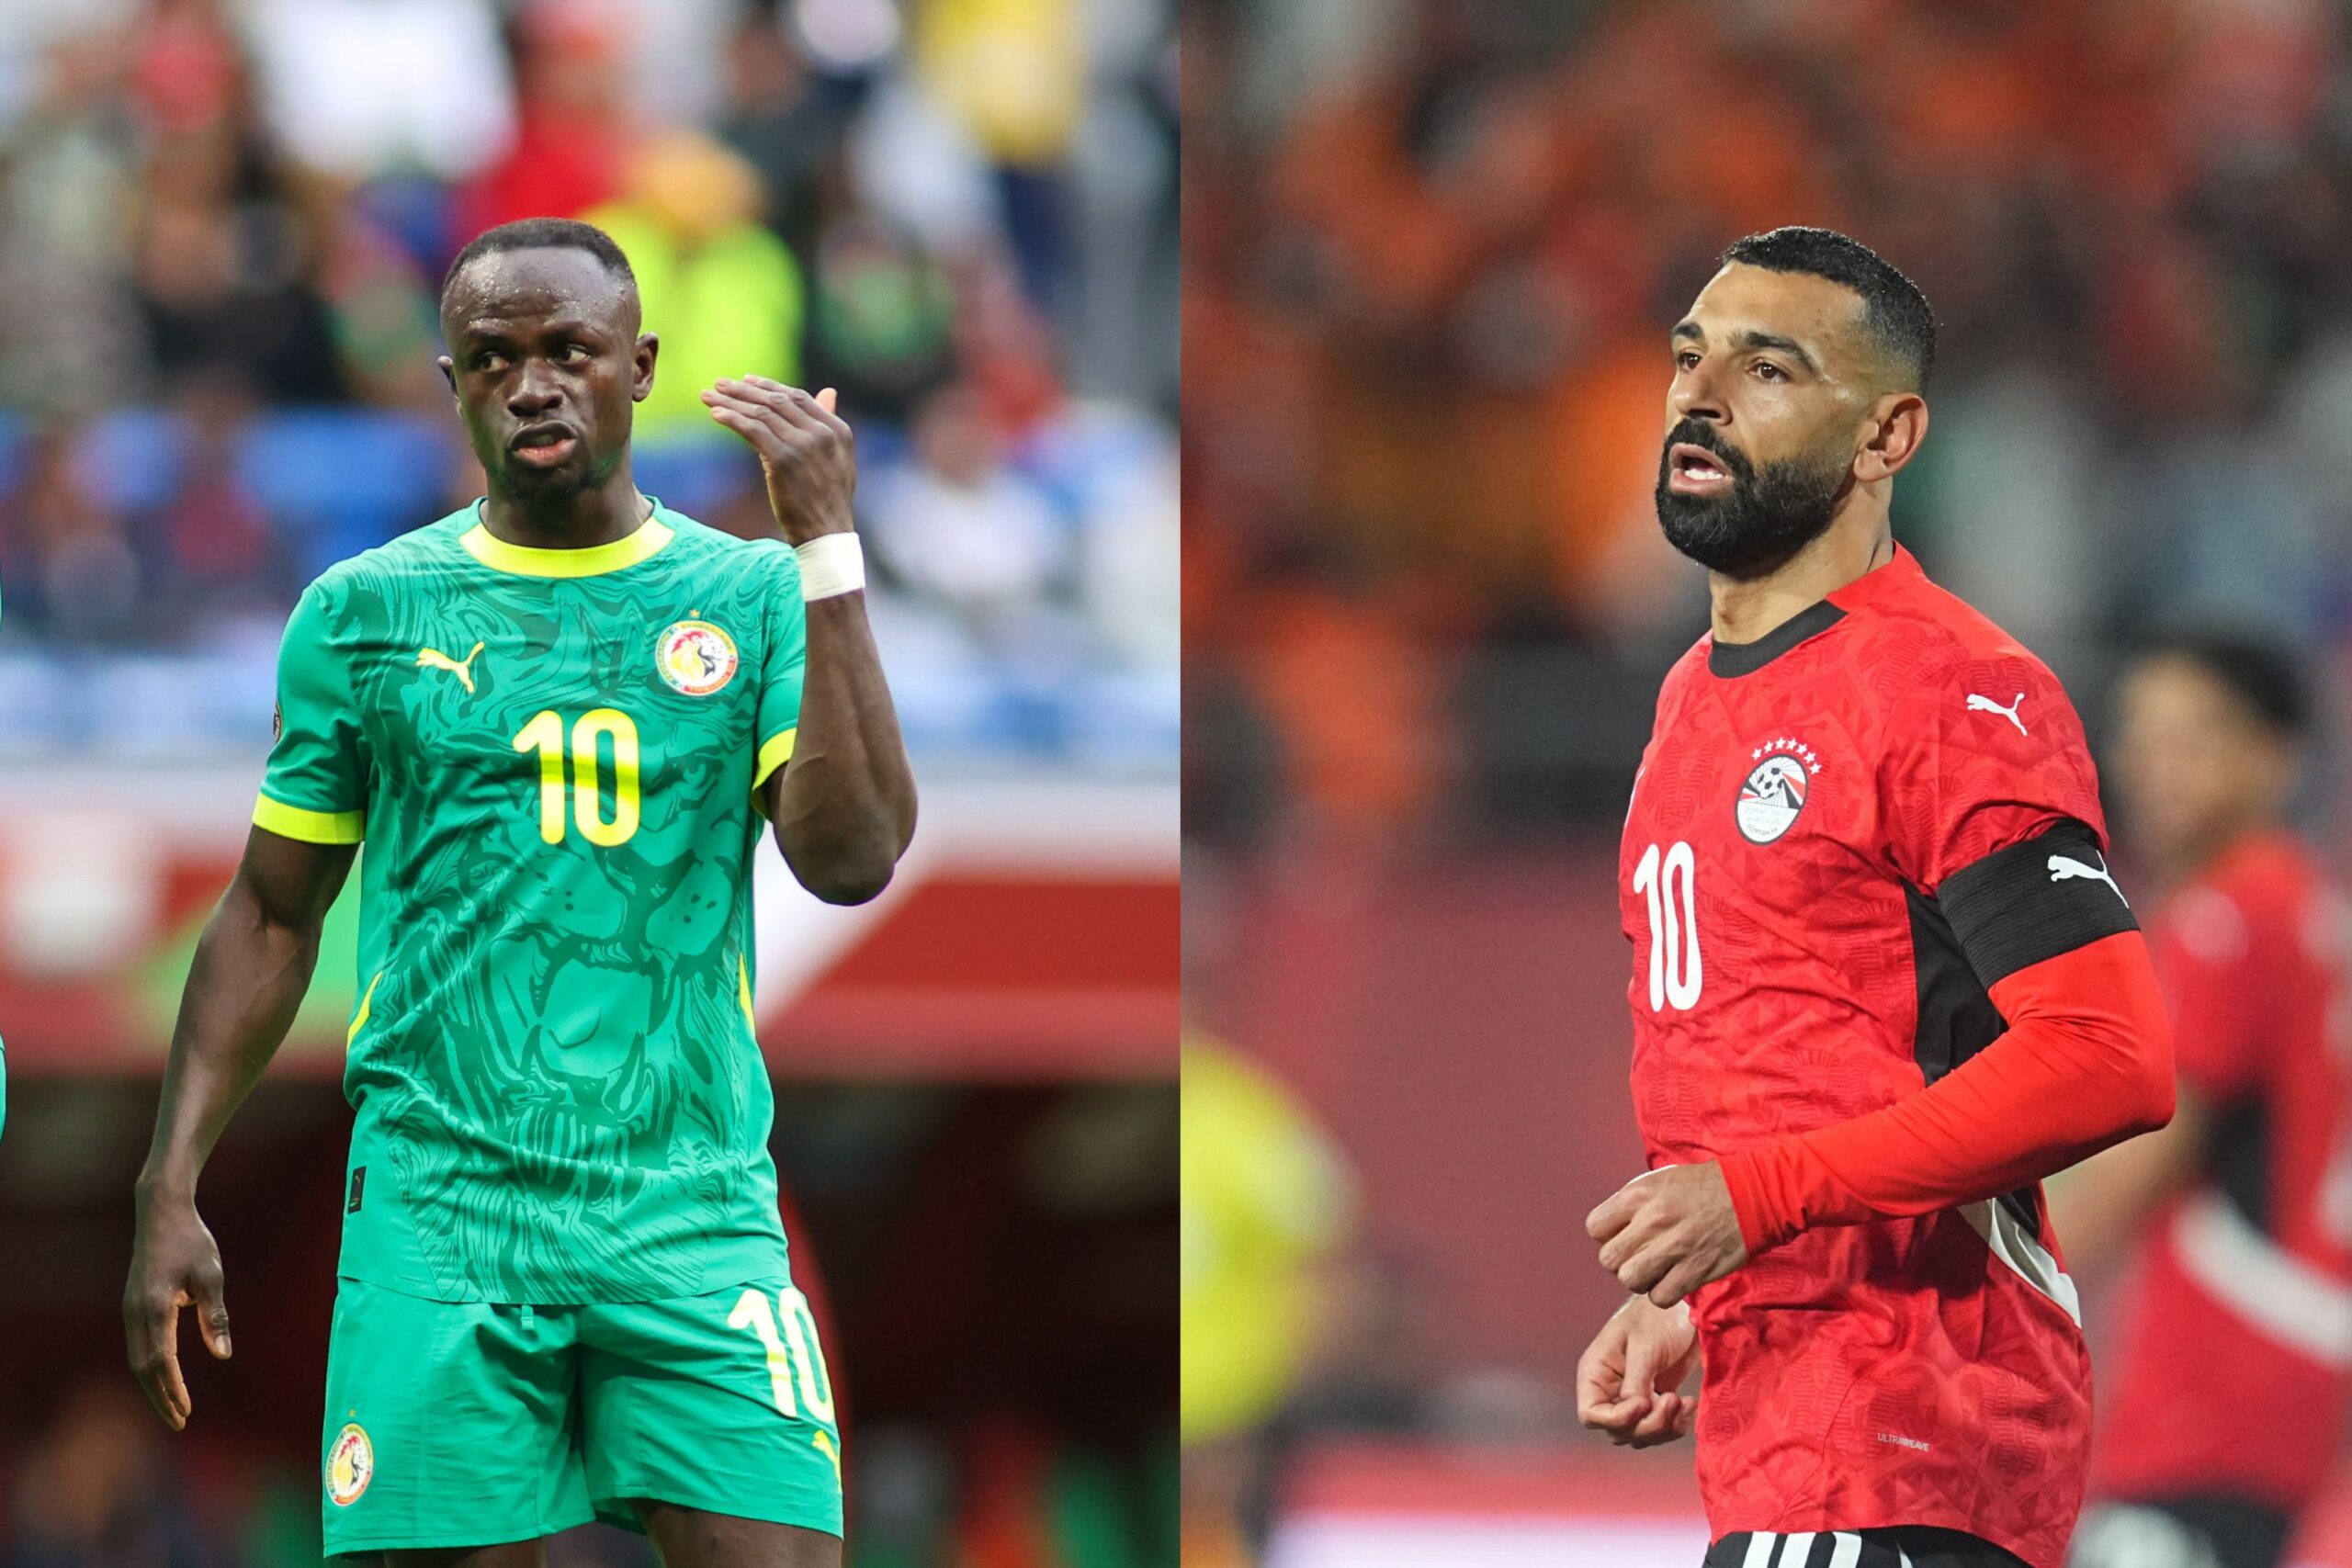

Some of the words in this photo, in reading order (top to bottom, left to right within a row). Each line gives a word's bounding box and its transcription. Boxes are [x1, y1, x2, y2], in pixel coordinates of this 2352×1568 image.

[512, 707, 640, 847] 10
[1633, 840, 1702, 1012] 10
[727, 1287, 834, 1422] 10
[1877, 1432, 1929, 1451] ULTRAWEAVE
